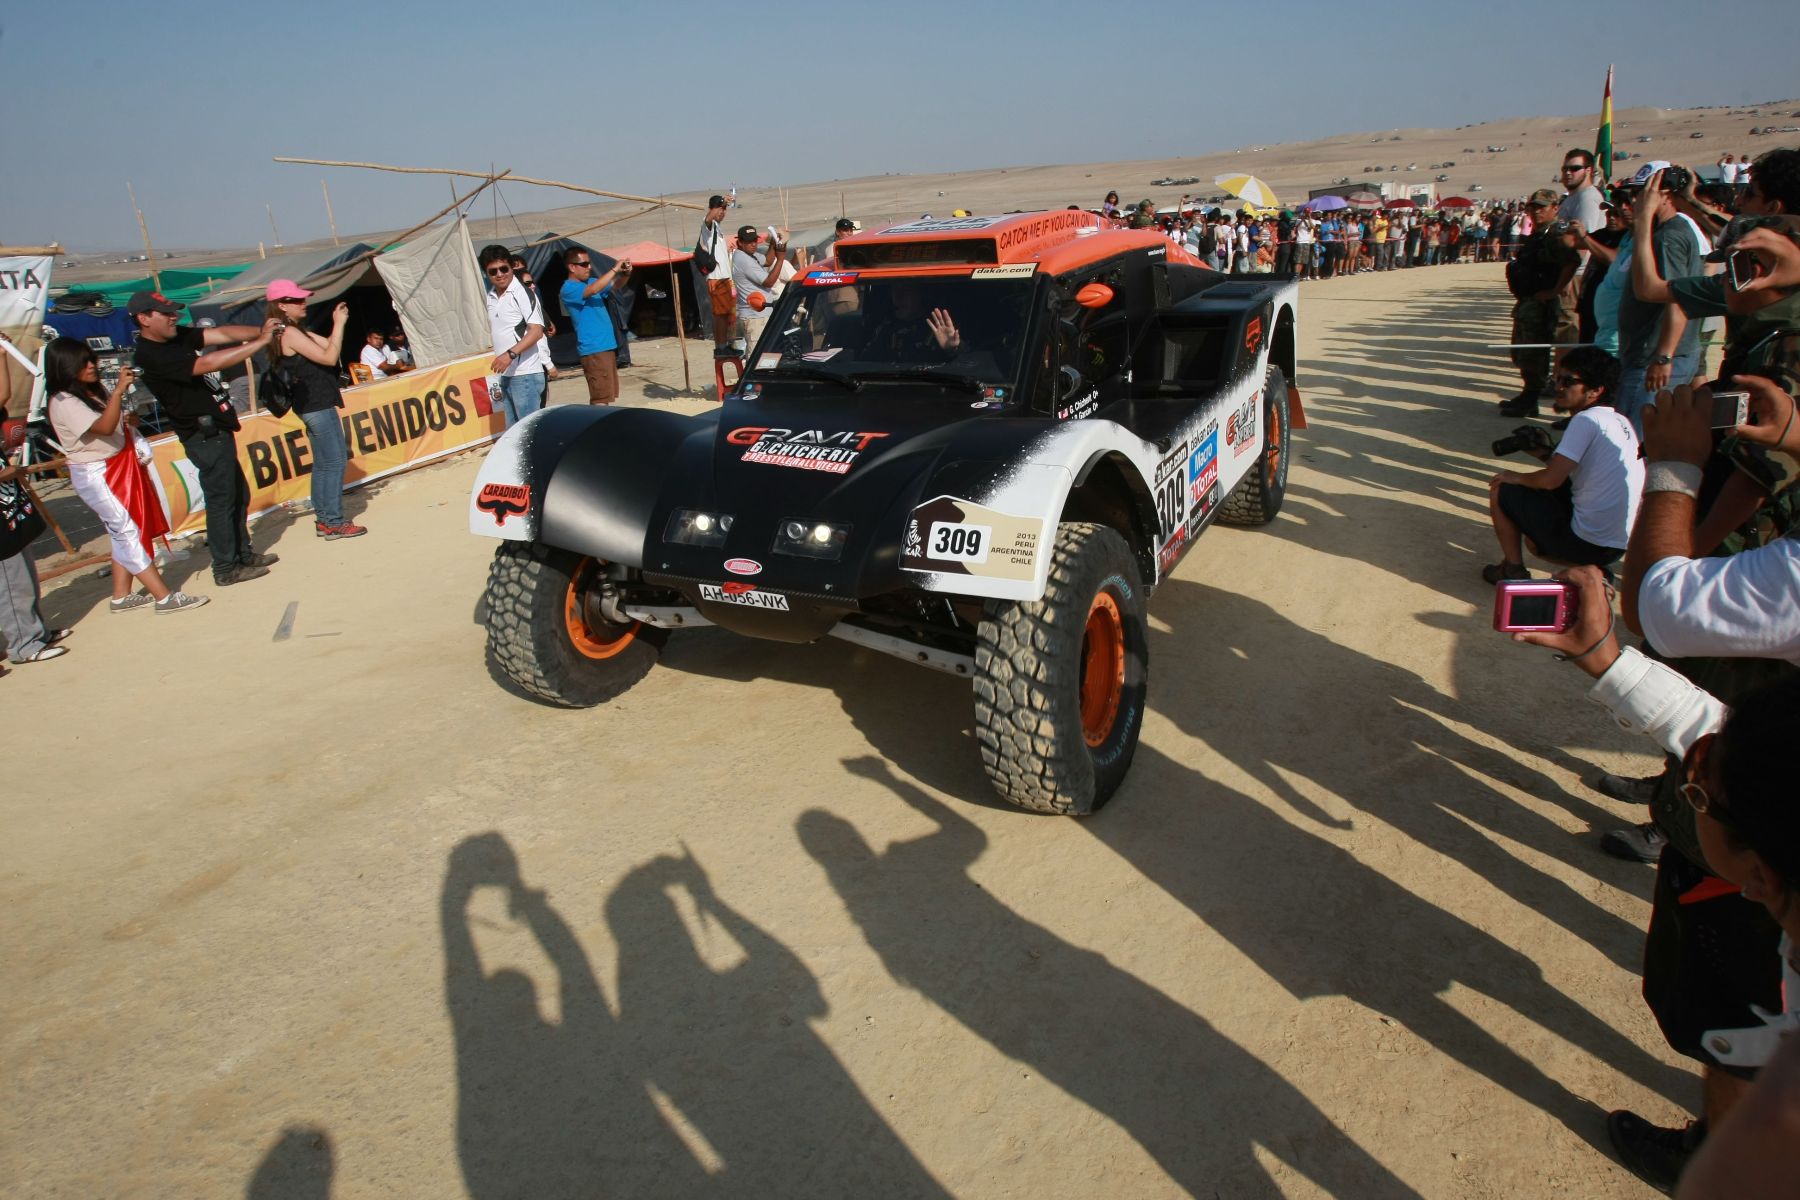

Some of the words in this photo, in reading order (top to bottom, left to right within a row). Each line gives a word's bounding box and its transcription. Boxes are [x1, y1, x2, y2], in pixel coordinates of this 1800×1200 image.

[1000, 227, 1028, 250] CATCH
[1030, 222, 1041, 239] ME
[1041, 220, 1050, 236] IF
[1050, 216, 1065, 233] YOU
[1065, 213, 1080, 228] CAN
[975, 266, 1033, 275] dakar.com
[246, 383, 467, 490] BIEVENIDOS
[1190, 417, 1217, 452] dakar.com
[768, 442, 860, 464] CHICHERIT
[1194, 442, 1213, 474] Macro
[1195, 464, 1218, 496] TOTAL
[1156, 468, 1186, 546] 309
[935, 526, 982, 556] 309
[1014, 540, 1035, 549] PERU
[1016, 532, 1037, 540] 2013
[990, 547, 1034, 557] ARGENTINA
[1010, 557, 1032, 566] CHILE
[703, 586, 788, 610] AH-056-WK
